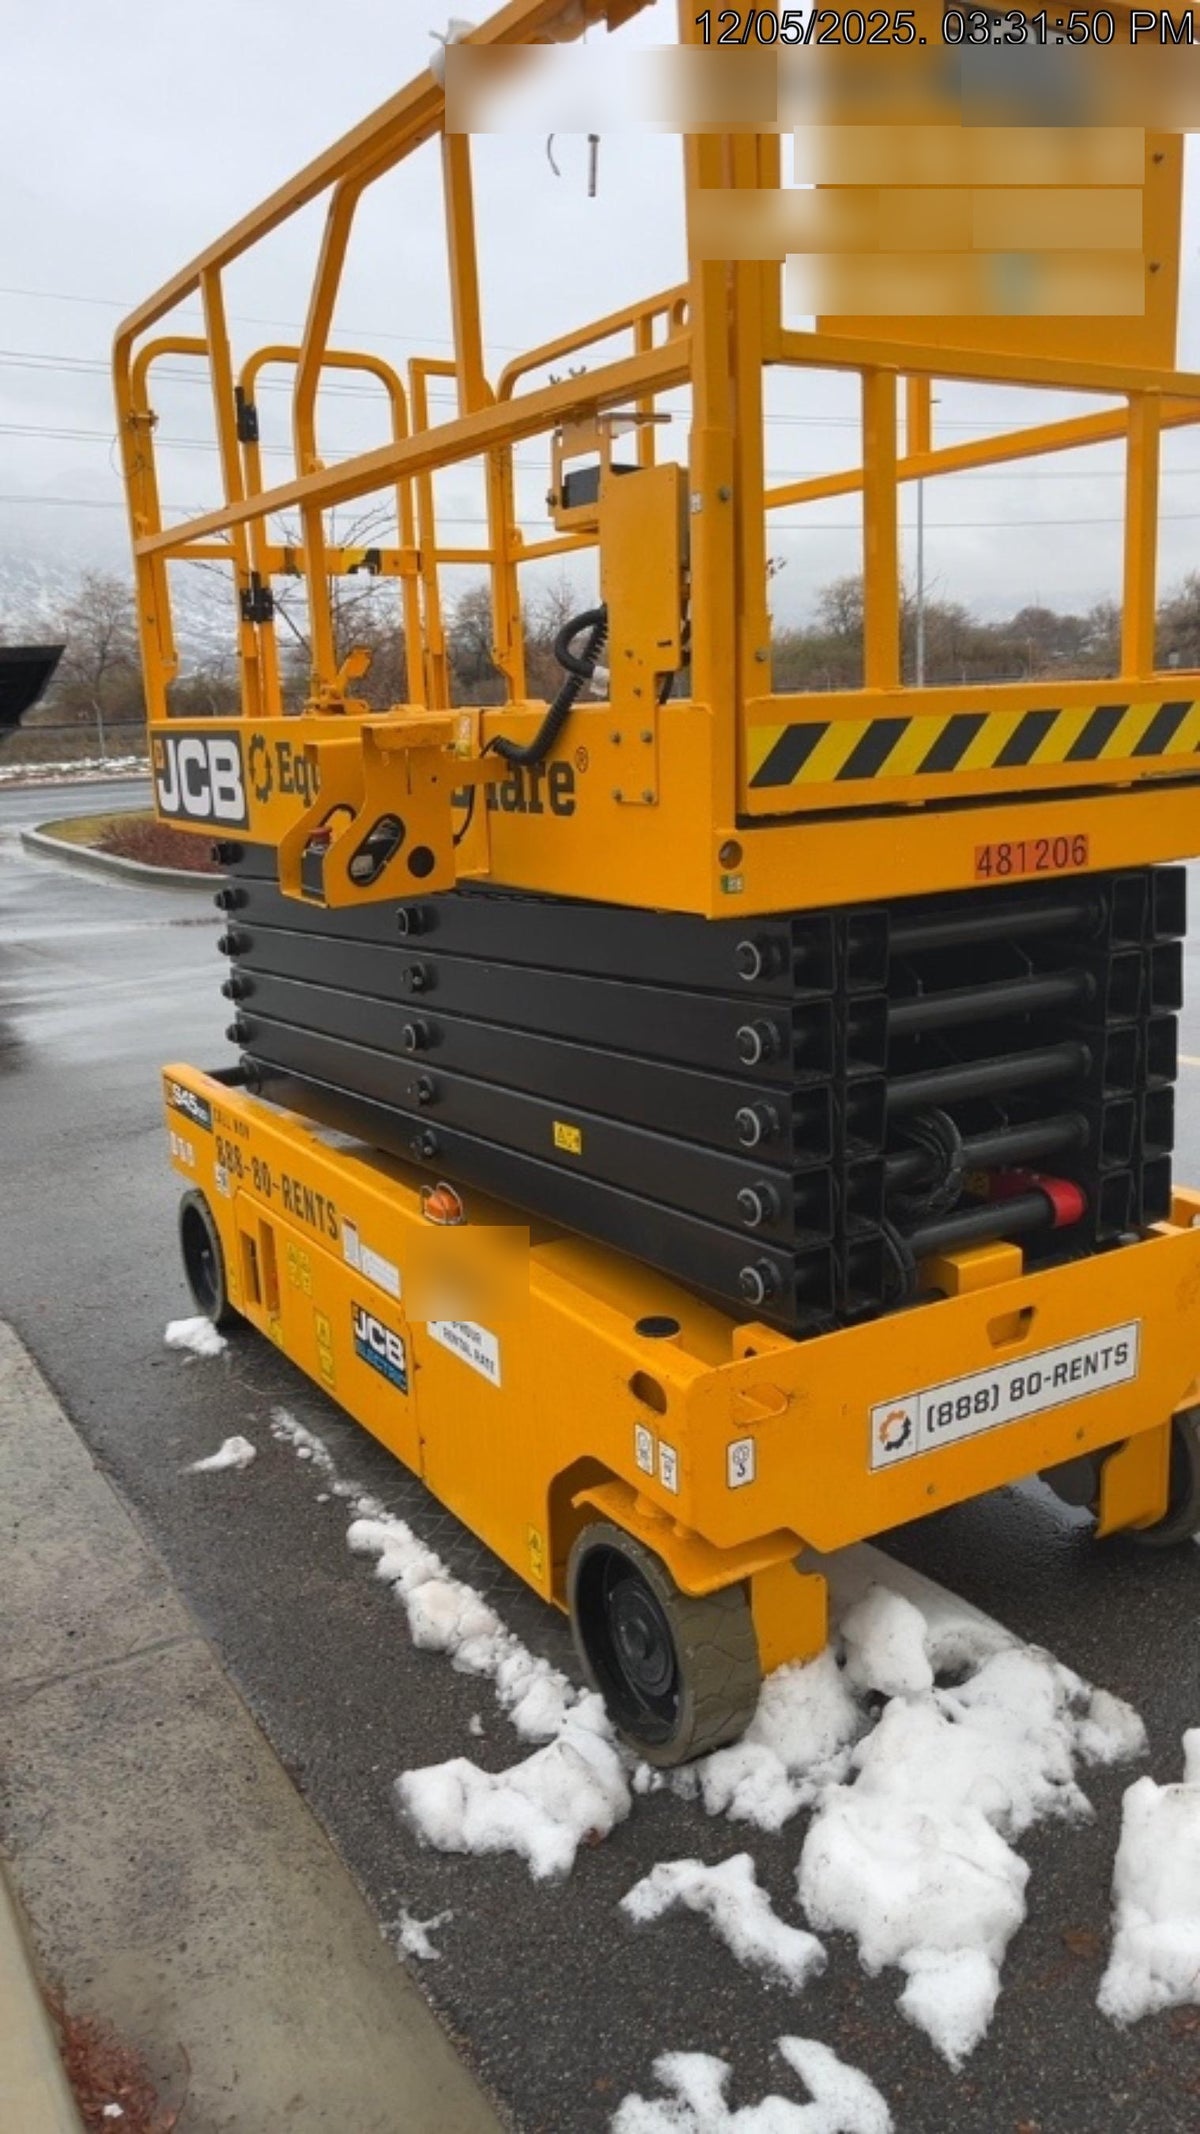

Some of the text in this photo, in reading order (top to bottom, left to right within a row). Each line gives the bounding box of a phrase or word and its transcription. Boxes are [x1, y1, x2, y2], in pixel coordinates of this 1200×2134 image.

[157, 739, 245, 821] JCB
[977, 834, 1087, 877] 481206
[355, 1310, 405, 1371] JCB
[926, 1342, 1128, 1433] (888) 80-RENTS
